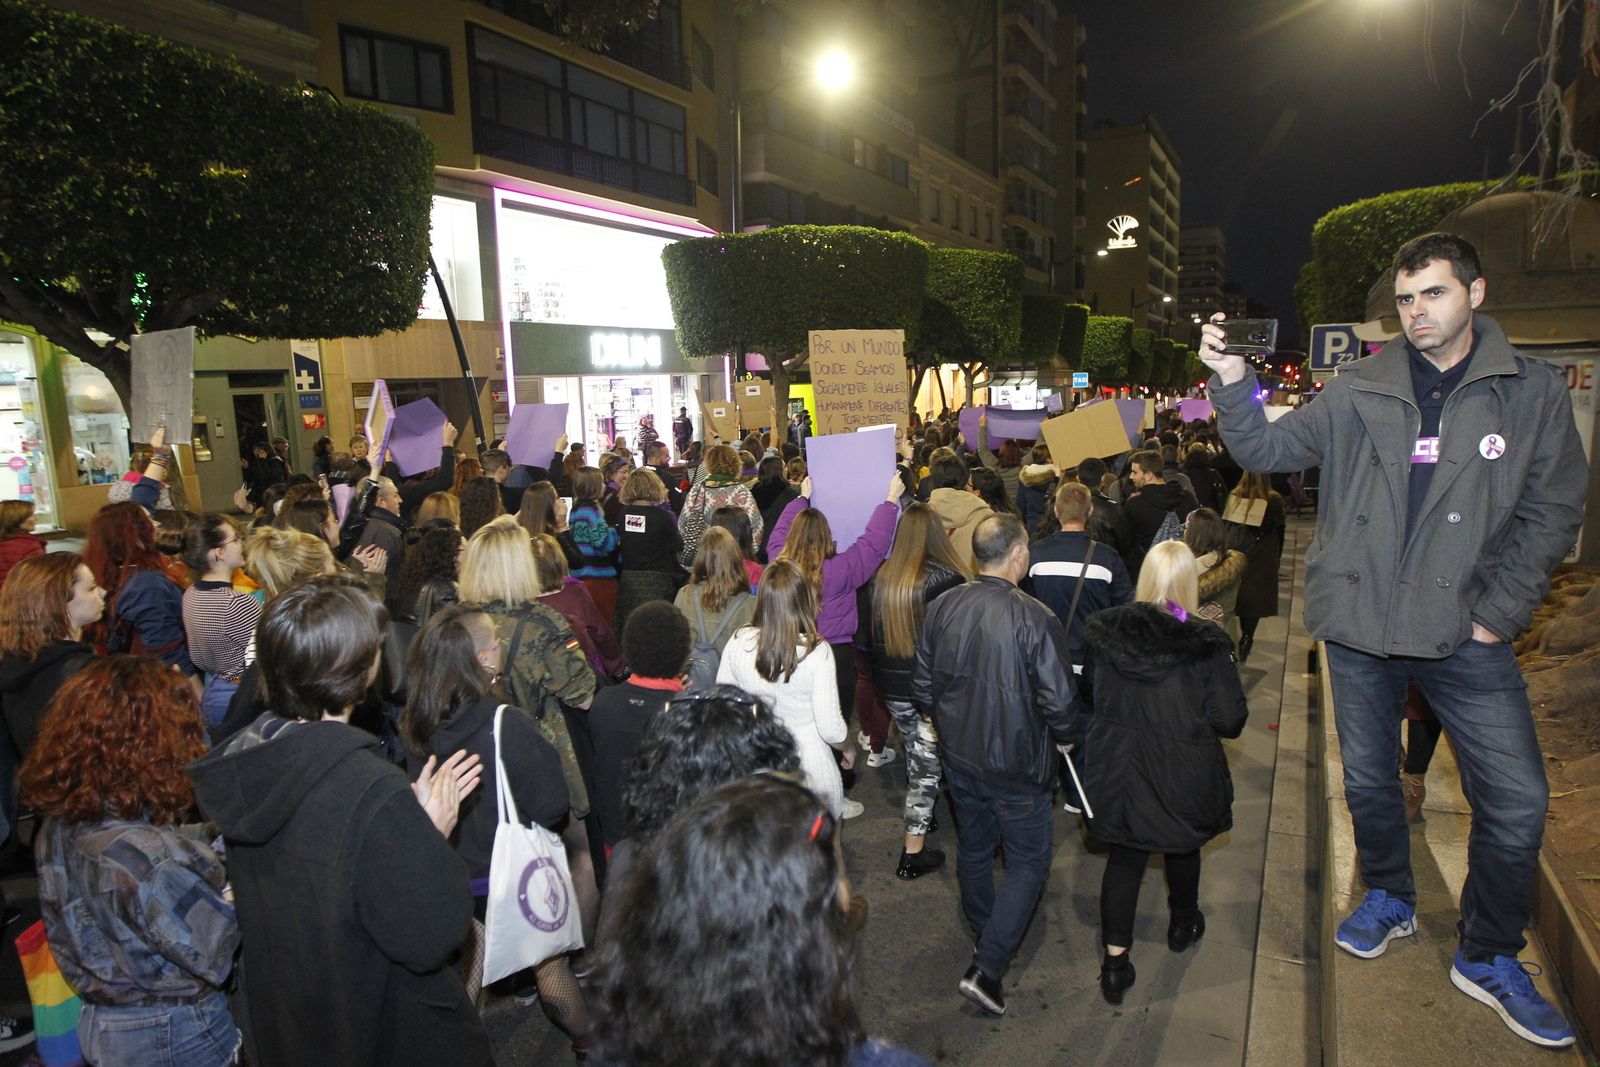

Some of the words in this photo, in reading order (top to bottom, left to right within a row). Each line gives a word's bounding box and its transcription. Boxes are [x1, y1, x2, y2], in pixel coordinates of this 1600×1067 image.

[812, 334, 835, 355] POR
[841, 338, 856, 354] UN
[862, 338, 900, 356] MUNDO
[1324, 331, 1349, 364] P
[814, 361, 847, 375] DONDE
[855, 360, 896, 376] SEAMOS
[825, 414, 833, 424] Y
